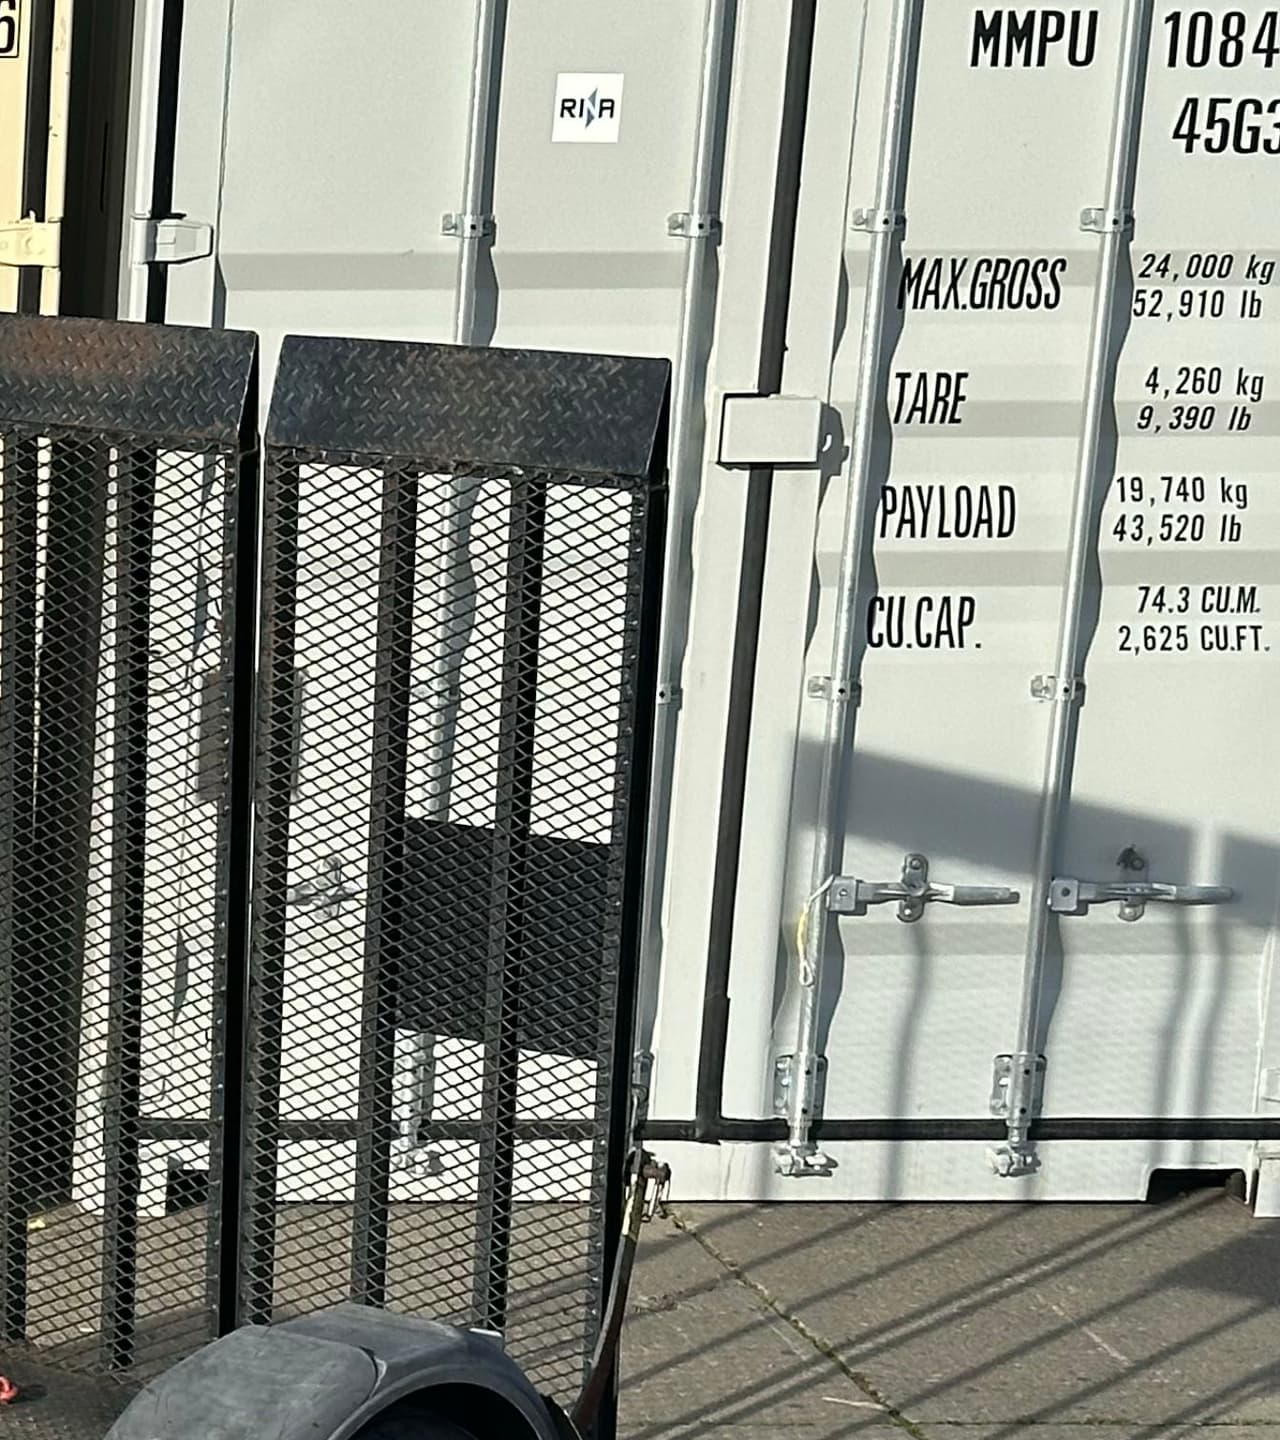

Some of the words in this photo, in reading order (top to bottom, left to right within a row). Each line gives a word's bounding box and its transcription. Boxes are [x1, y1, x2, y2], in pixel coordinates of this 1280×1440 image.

[969, 10, 1098, 69] MMPU
[1164, 11, 1280, 68] 1084
[560, 91, 615, 125] RINA
[1172, 97, 1280, 154] 45G3
[897, 257, 1067, 310] MAX.GROSS
[1138, 253, 1234, 282] 24,000
[1245, 254, 1276, 285] kg
[1133, 289, 1225, 322] 52,910
[1241, 289, 1262, 318] lb
[892, 372, 968, 424] TARE
[1145, 366, 1222, 399] 4,260
[1236, 367, 1264, 402] kg
[1137, 405, 1216, 433] 9,390
[1228, 406, 1251, 431] lb
[1116, 476, 1205, 507] 19,740
[1220, 477, 1248, 509] kg
[879, 485, 1016, 538] PAYLOAD
[1113, 514, 1205, 546] 43,520
[1220, 514, 1242, 542] lb
[1138, 586, 1190, 613] 74.3
[1201, 586, 1261, 613] CU.M.
[1118, 625, 1189, 656] 2,625
[1200, 625, 1270, 651] CU.FT.
